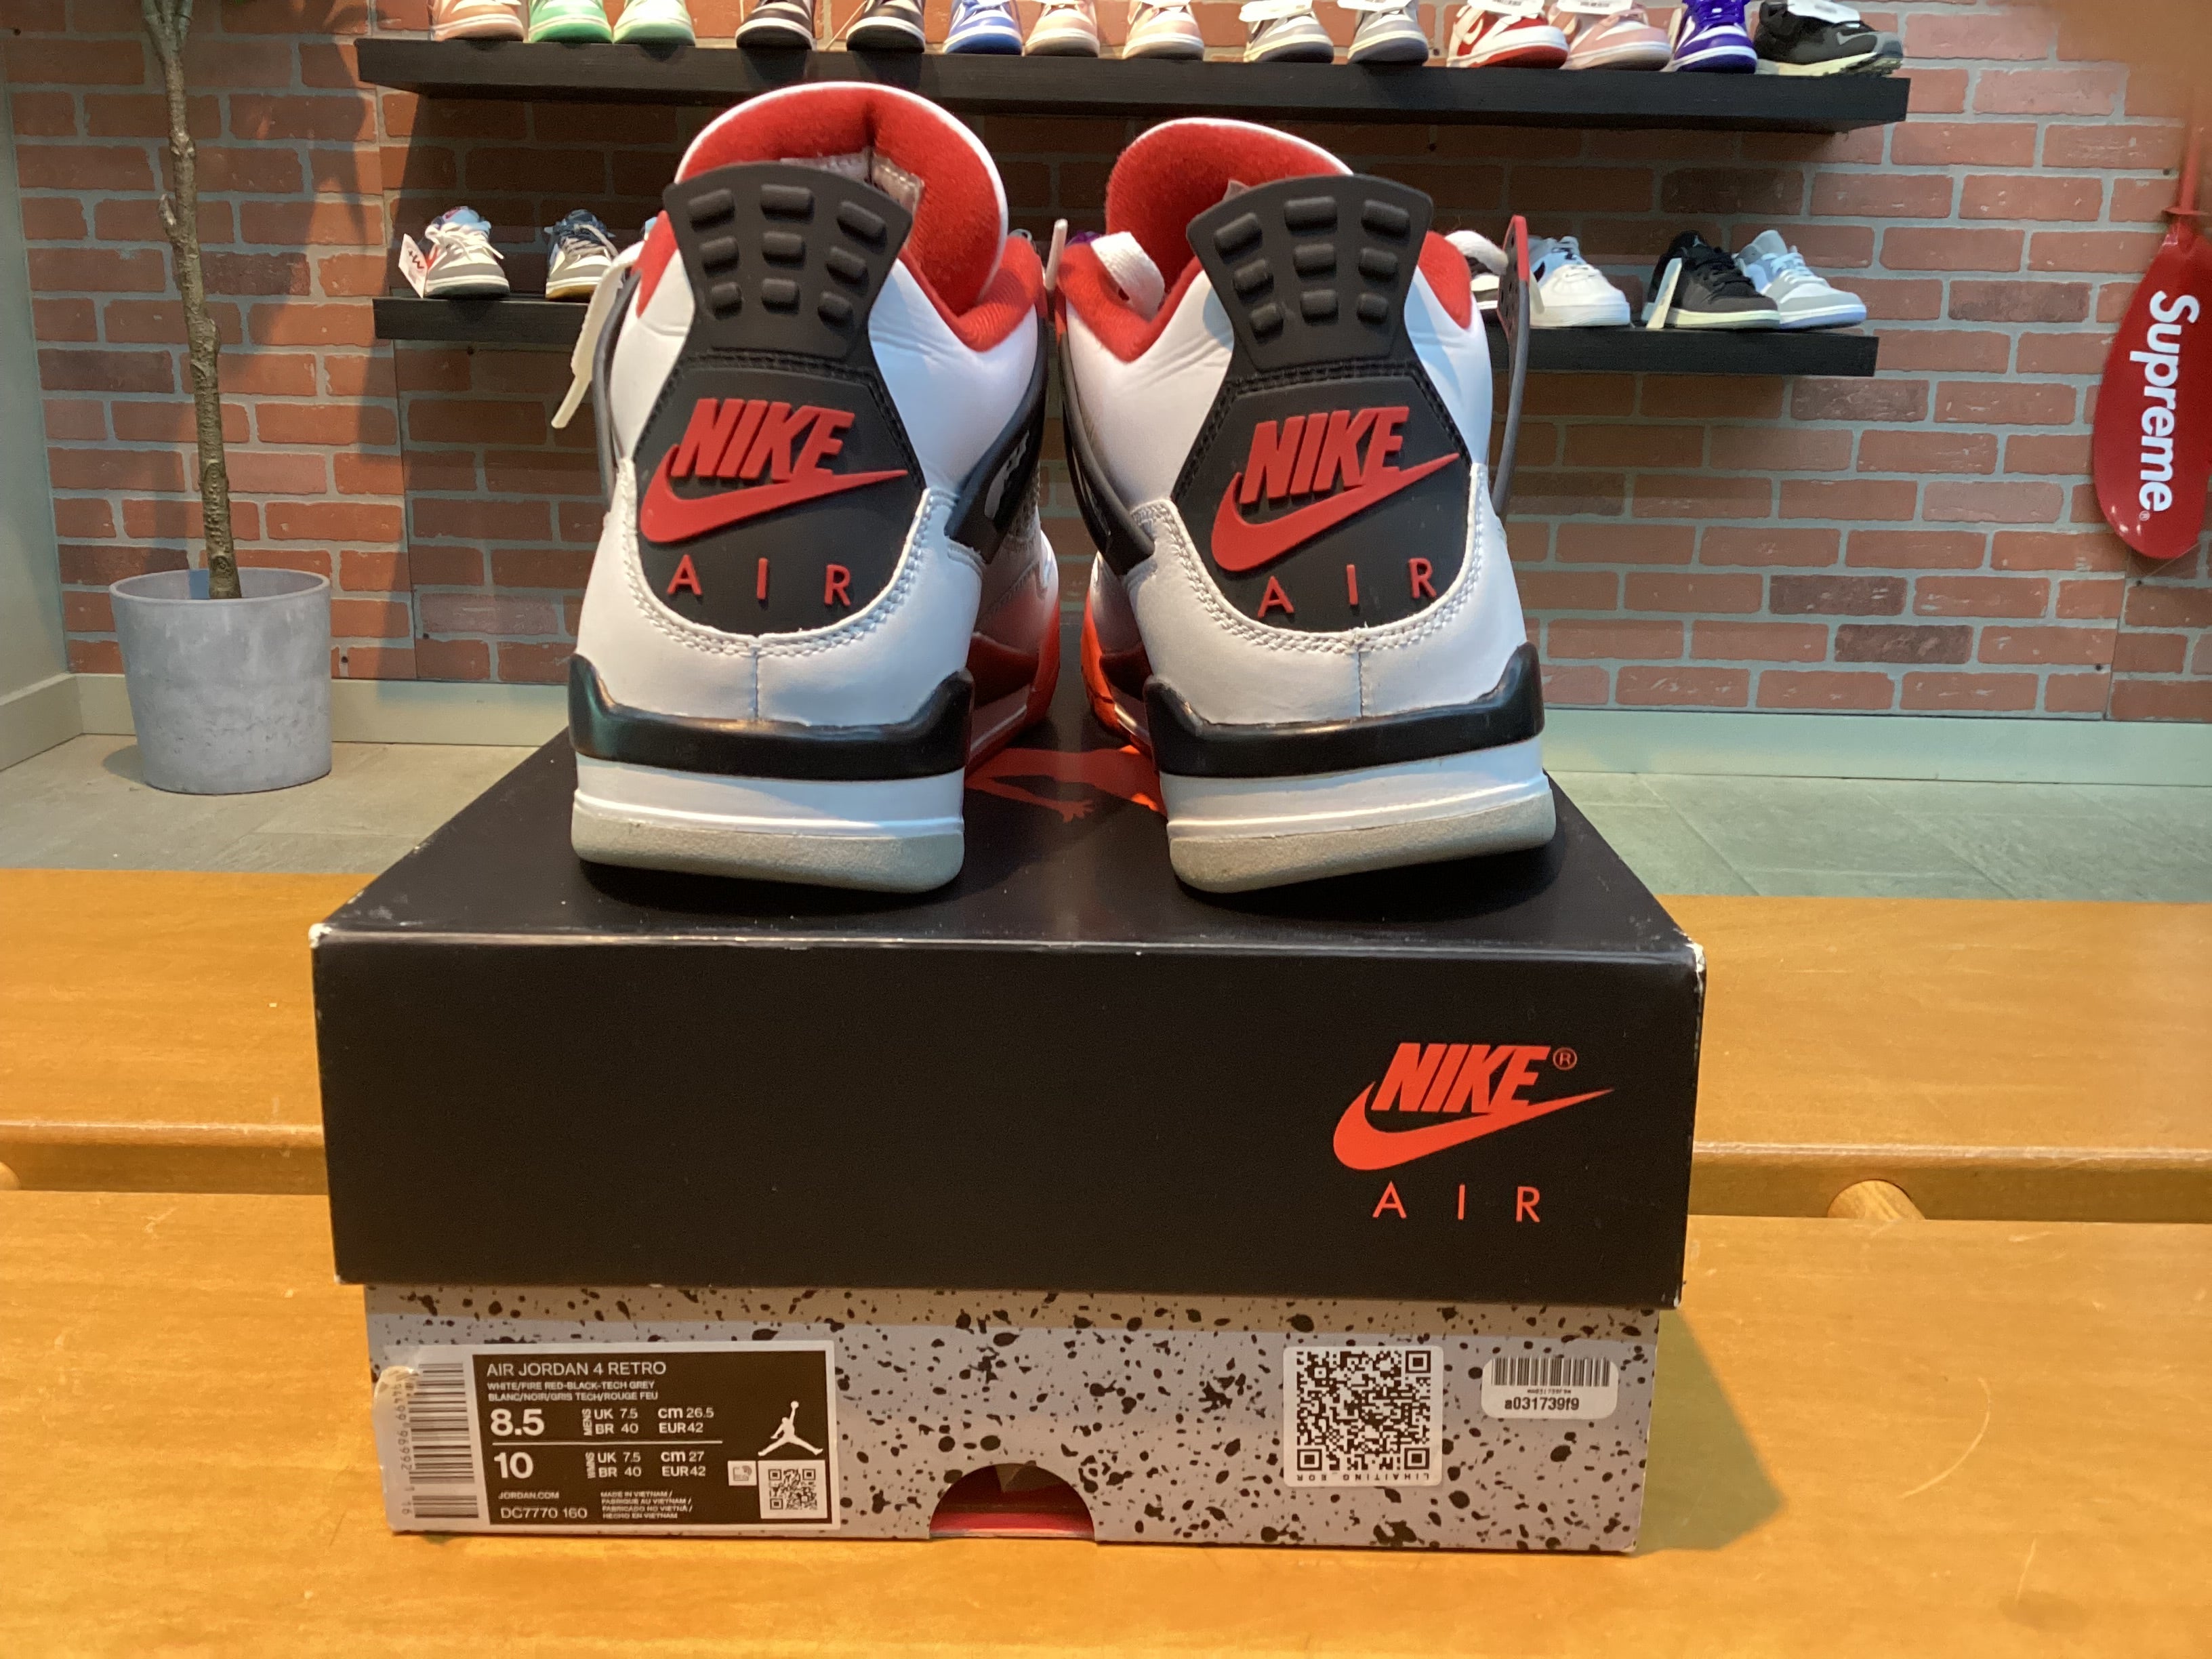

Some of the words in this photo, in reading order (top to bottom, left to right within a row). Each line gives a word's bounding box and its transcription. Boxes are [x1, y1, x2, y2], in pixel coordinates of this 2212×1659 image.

[2129, 290, 2200, 512] Supreme
[670, 398, 855, 483] NIKE
[1239, 406, 1410, 505] NIKE
[667, 554, 851, 608] AIR
[1257, 557, 1437, 618] AIR
[1370, 1042, 1551, 1113] NIKE
[1372, 1181, 1540, 1223] AIR
[487, 1363, 514, 1377] AIR
[518, 1362, 589, 1376] JORDAN
[593, 1362, 604, 1375] 4
[608, 1361, 667, 1375] RETRO
[629, 1380, 655, 1389] GREY
[640, 1391, 659, 1400] FEU
[594, 1408, 614, 1420] UK
[619, 1408, 638, 1419] 7.5
[657, 1408, 684, 1419] cm
[686, 1407, 714, 1419] 26.5
[1504, 1396, 1580, 1411] a031739f9
[490, 1408, 545, 1437] 8.5
[581, 1408, 593, 1436] MENS
[595, 1423, 615, 1435] BR
[620, 1422, 639, 1434] 40
[659, 1422, 687, 1434] EUR
[687, 1422, 704, 1433] 42
[493, 1452, 534, 1479] 10
[597, 1452, 617, 1464] UK
[622, 1451, 642, 1463] 7.5
[660, 1451, 686, 1462] cm
[689, 1451, 705, 1462] 27
[598, 1466, 618, 1478] BR
[624, 1466, 642, 1477] 40
[661, 1465, 689, 1477] EUR
[689, 1465, 706, 1477] 42
[500, 1507, 558, 1519] DC7770
[562, 1507, 588, 1519] 160
